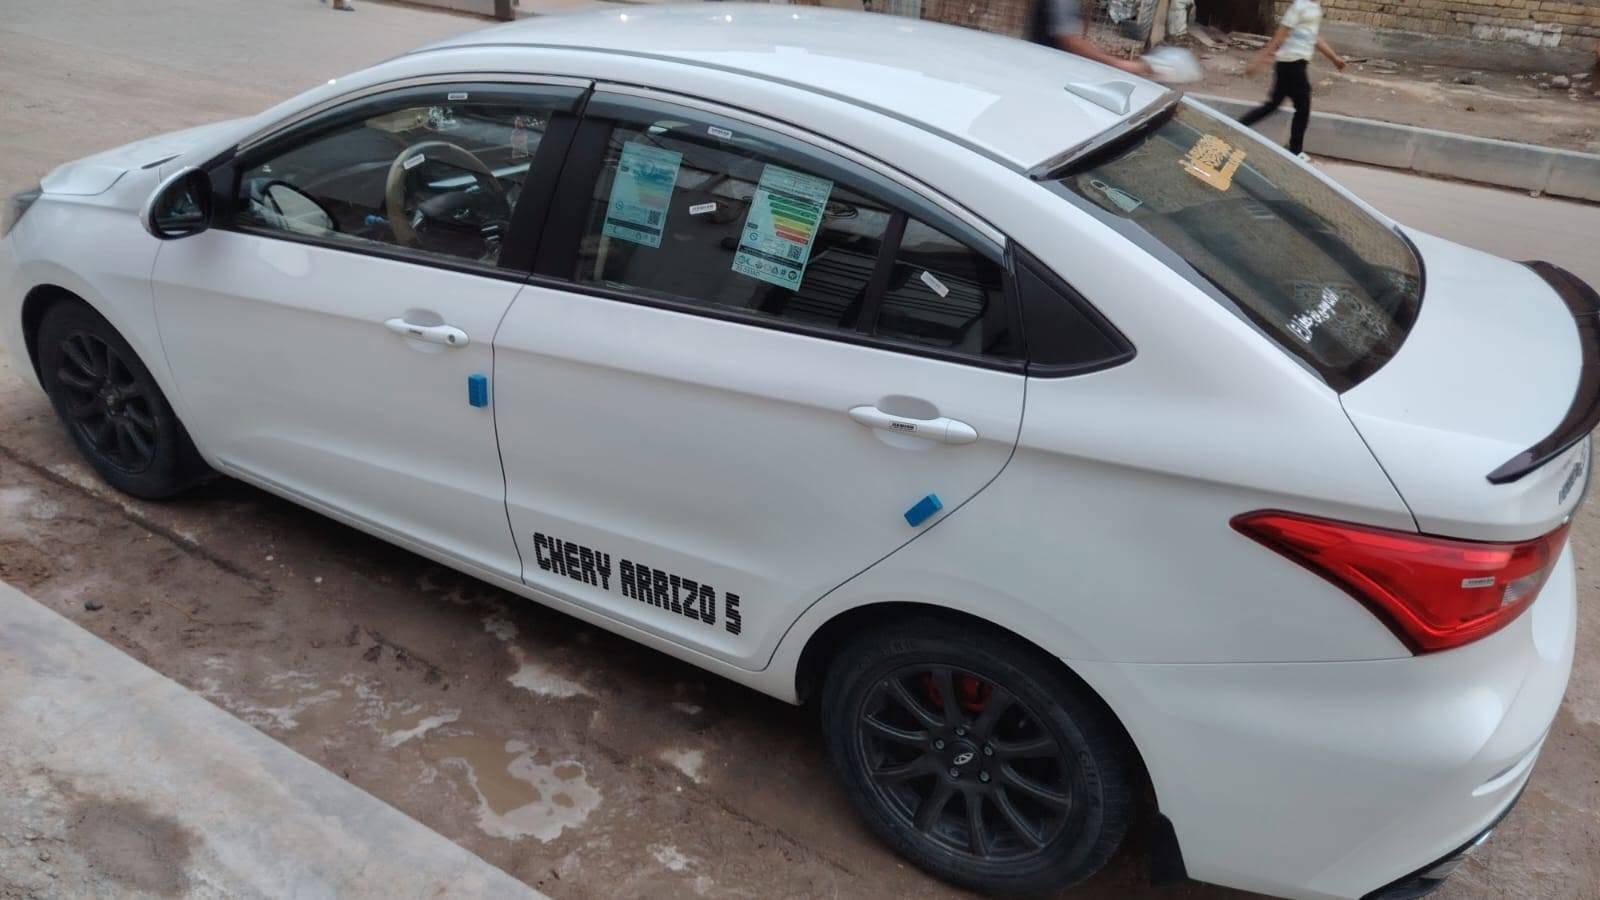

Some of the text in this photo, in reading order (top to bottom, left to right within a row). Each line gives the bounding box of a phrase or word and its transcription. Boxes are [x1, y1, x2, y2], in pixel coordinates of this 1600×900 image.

[533, 532, 742, 635] CHERY ARRIZO 5
